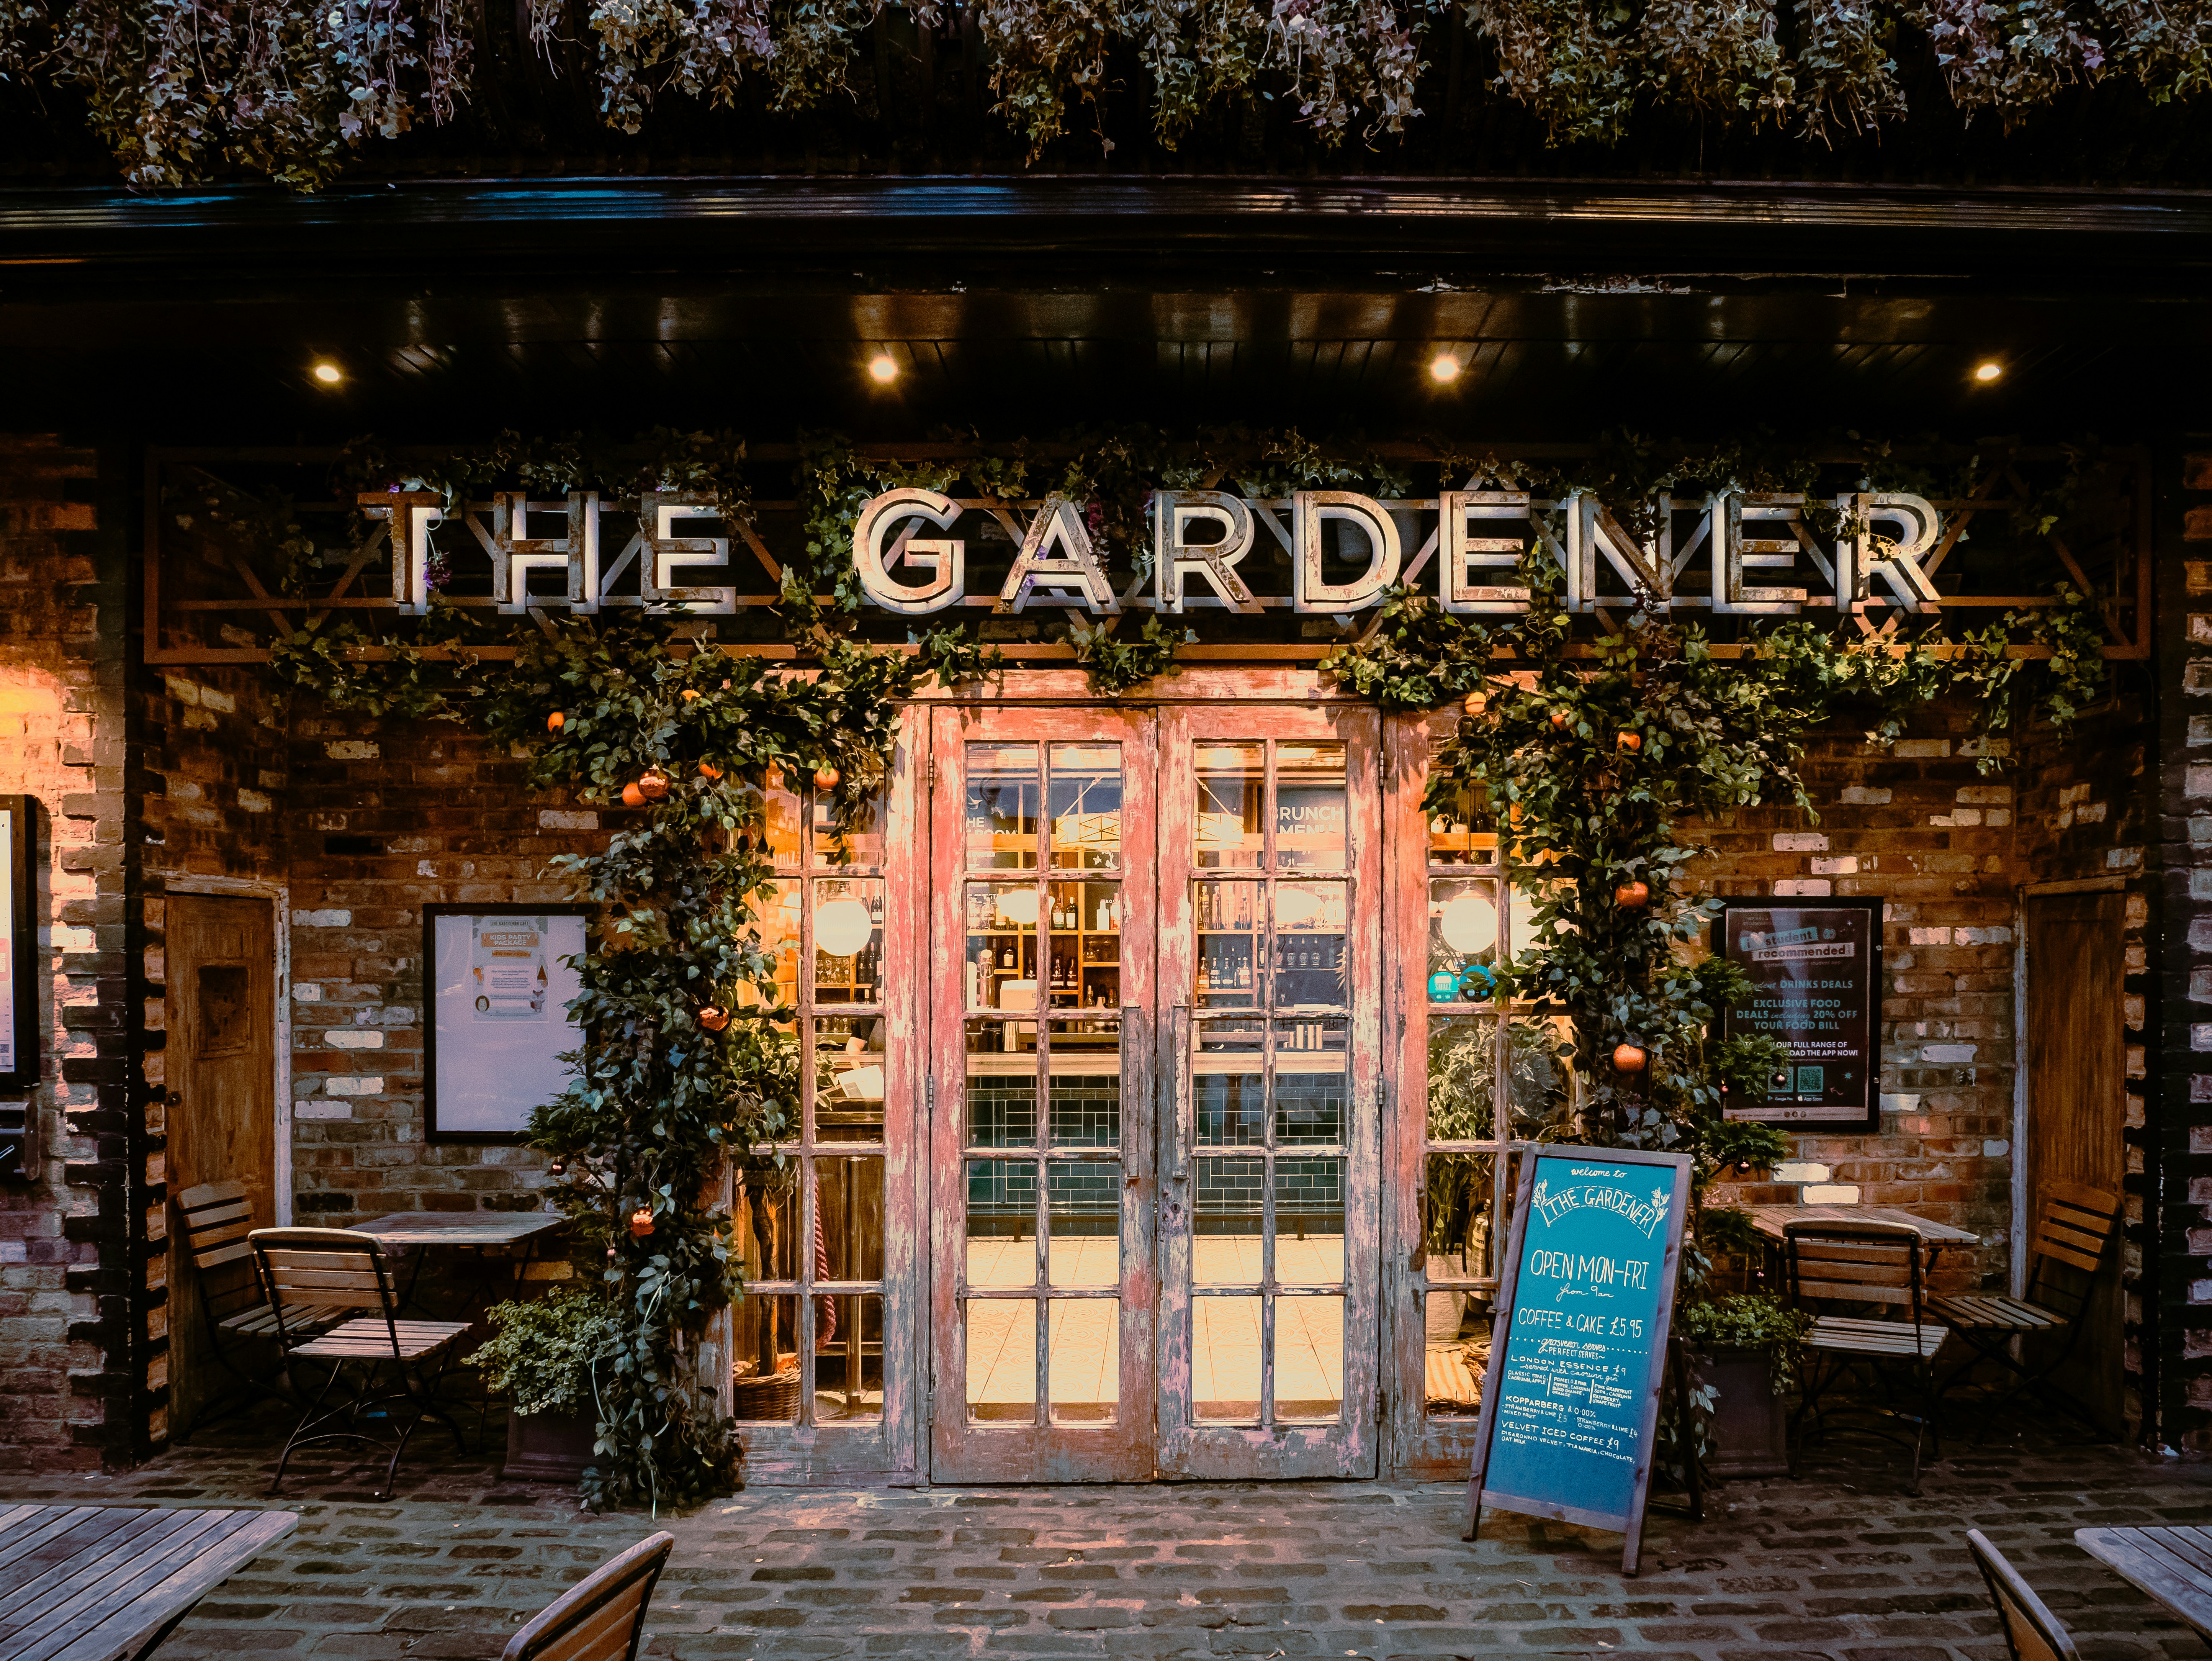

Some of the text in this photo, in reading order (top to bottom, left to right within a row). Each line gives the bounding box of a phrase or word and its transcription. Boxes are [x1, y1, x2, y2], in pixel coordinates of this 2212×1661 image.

[358, 487, 1942, 615] THE GARDENER
[1765, 930, 1813, 946] student
[1759, 945, 1846, 958] recommended
[1780, 980, 1818, 989] DRINKS
[1821, 980, 1853, 988] DEALS
[1754, 999, 1841, 1007] EXCLUSIVE FOOD
[1736, 1010, 1769, 1019] DEALS
[1814, 1010, 1836, 1019] 20%
[1838, 1010, 1857, 1018] OFF
[1754, 1021, 1839, 1030] YOUR FOOD BILL
[1571, 1166, 1627, 1178] welcome to
[1545, 1188, 1656, 1229] THE GARDENER
[1531, 1250, 1649, 1289] OPEN MON-FRI
[1556, 1283, 1614, 1302] from 9am
[1518, 1308, 1563, 1329] COFFEE
[1566, 1315, 1574, 1328] &
[1576, 1314, 1606, 1335] CAKE
[1538, 1338, 1606, 1354] grosvenor serves
[1548, 1347, 1598, 1360] PERFECT SERVES
[1511, 1355, 1626, 1377] LONDON ESSENCE £9
[1604, 1376, 1618, 1385] gin
[1606, 1386, 1633, 1395] GRAPEFRUIT
[1506, 1394, 1564, 1412] KOPPARBERG
[1592, 1399, 1621, 1408] GRAPEFRUIT
[1593, 1394, 1621, 1404] RASPBERRY,
[1557, 1413, 1567, 1423] £5
[1502, 1420, 1619, 1451] VELVET ICED COFFEE £9
[1629, 1428, 1638, 1438] £4
[1501, 1430, 1537, 1441] DISARONNO
[1539, 1437, 1565, 1447] VELVET,
[1600, 1450, 1635, 1464] CHOCOLATE,
